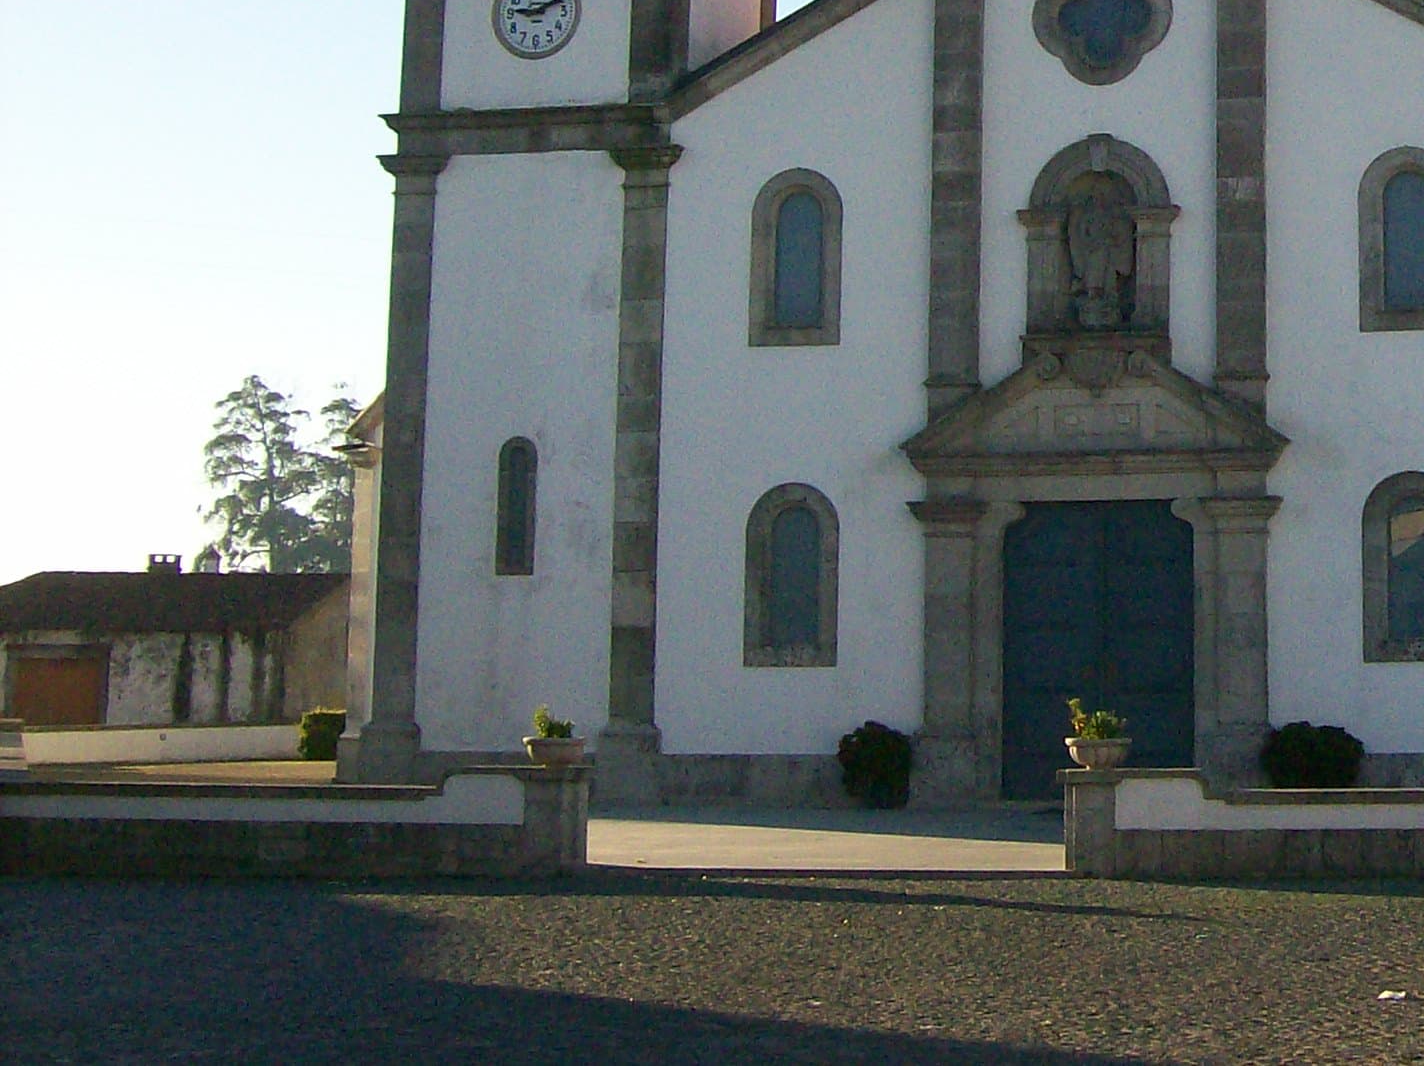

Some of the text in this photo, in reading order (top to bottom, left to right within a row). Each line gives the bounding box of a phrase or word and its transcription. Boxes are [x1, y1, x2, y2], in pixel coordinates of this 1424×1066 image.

[507, 8, 514, 20] 9
[560, 5, 568, 18] 3
[510, 22, 517, 34] 8
[555, 19, 562, 32] 4
[519, 31, 527, 44] 7
[532, 34, 540, 47] 6
[546, 30, 554, 43] 5
